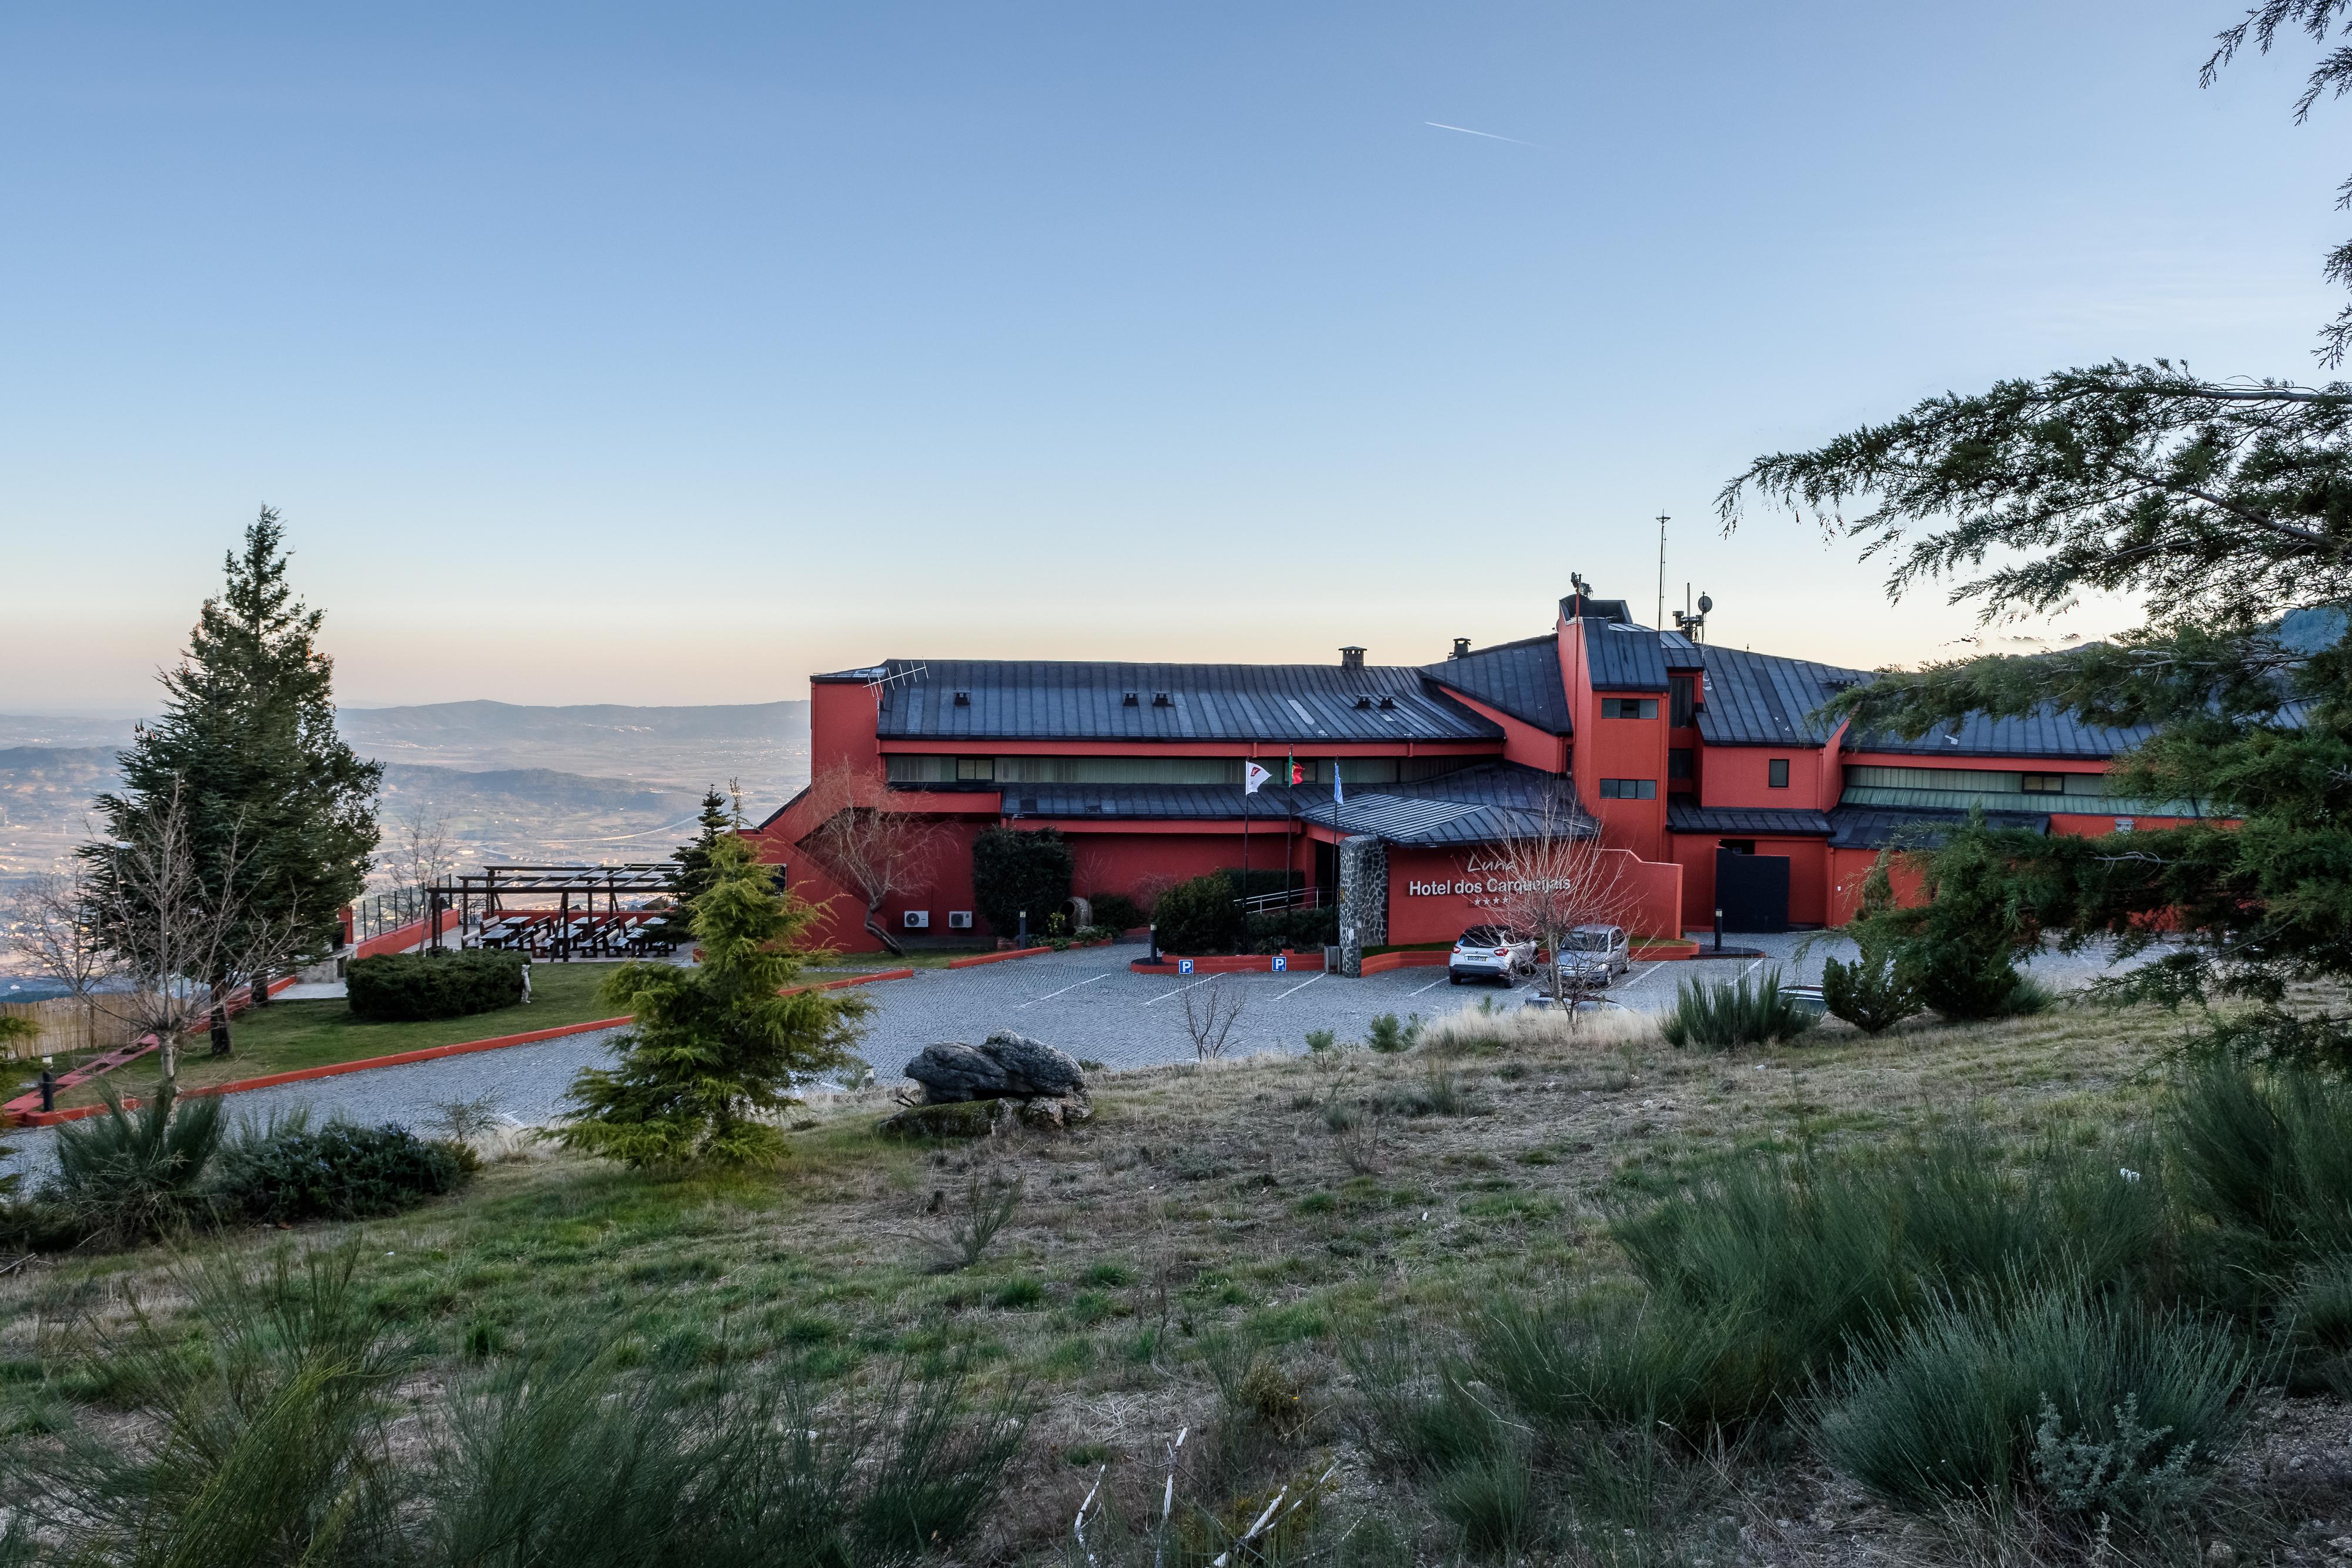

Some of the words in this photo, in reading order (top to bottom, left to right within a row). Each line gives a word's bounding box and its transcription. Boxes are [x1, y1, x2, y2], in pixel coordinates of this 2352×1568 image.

[1468, 854, 1516, 872] Luna
[1409, 880, 1450, 895] Hotel
[1455, 880, 1482, 893] dos
[1486, 877, 1571, 895] Carqueijais
[1182, 961, 1191, 972] P
[1276, 959, 1284, 969] P
